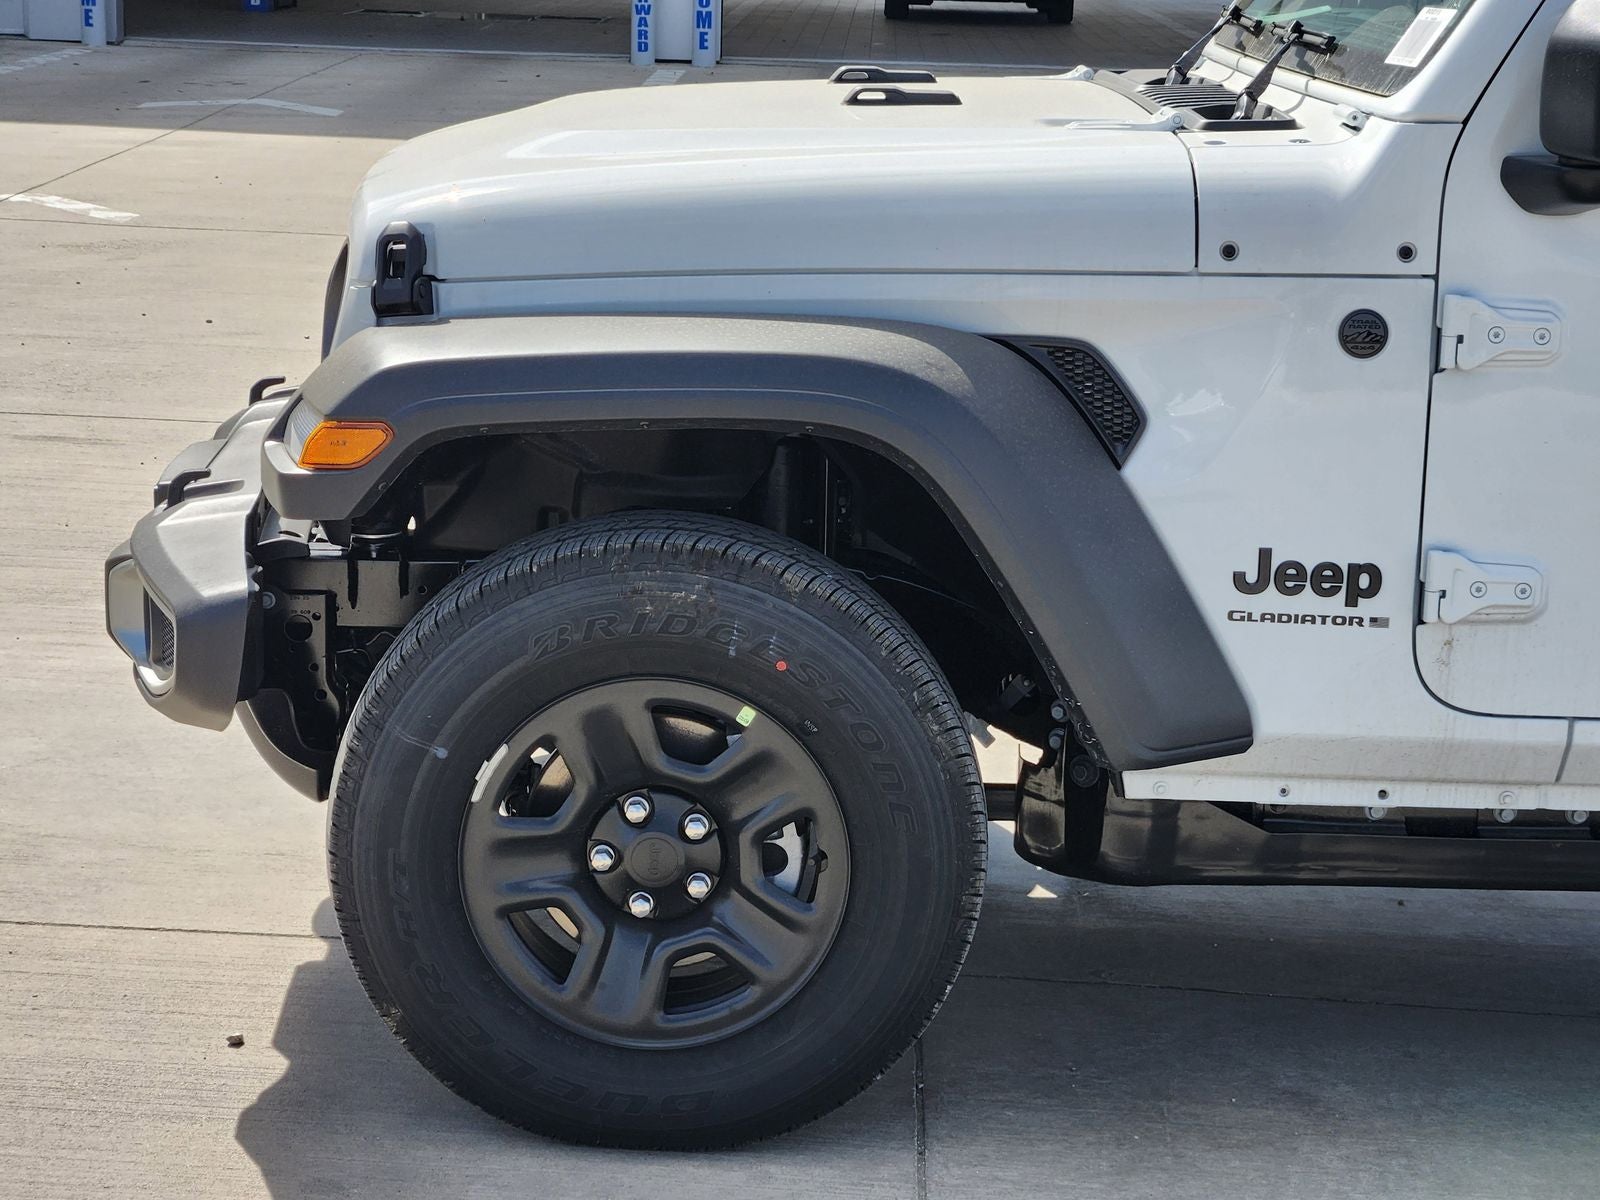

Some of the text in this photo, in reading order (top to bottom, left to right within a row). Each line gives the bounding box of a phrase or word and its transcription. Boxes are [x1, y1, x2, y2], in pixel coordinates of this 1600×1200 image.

[634, 0, 651, 52] WARD
[1232, 547, 1382, 608] Jeep
[1227, 610, 1365, 628] GLADIATOR
[526, 609, 921, 837] BRIDGESTONE
